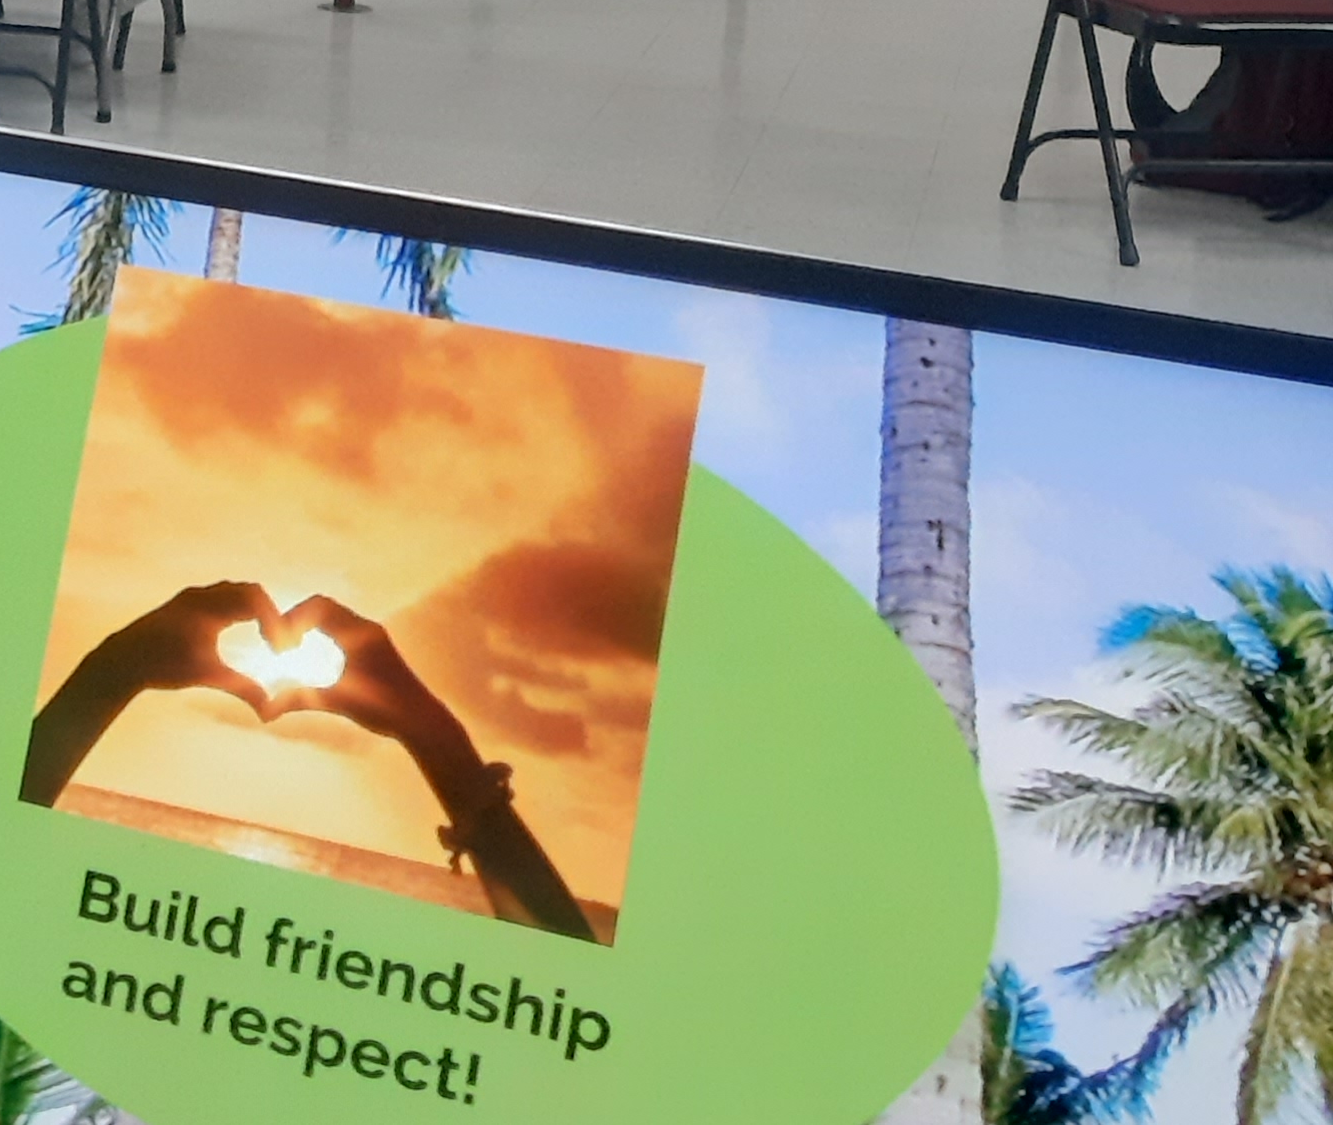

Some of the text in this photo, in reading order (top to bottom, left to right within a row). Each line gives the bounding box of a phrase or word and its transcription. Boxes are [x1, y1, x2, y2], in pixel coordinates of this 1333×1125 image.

[61, 960, 481, 1106] and respect!
[77, 870, 612, 1062] Build friendship
